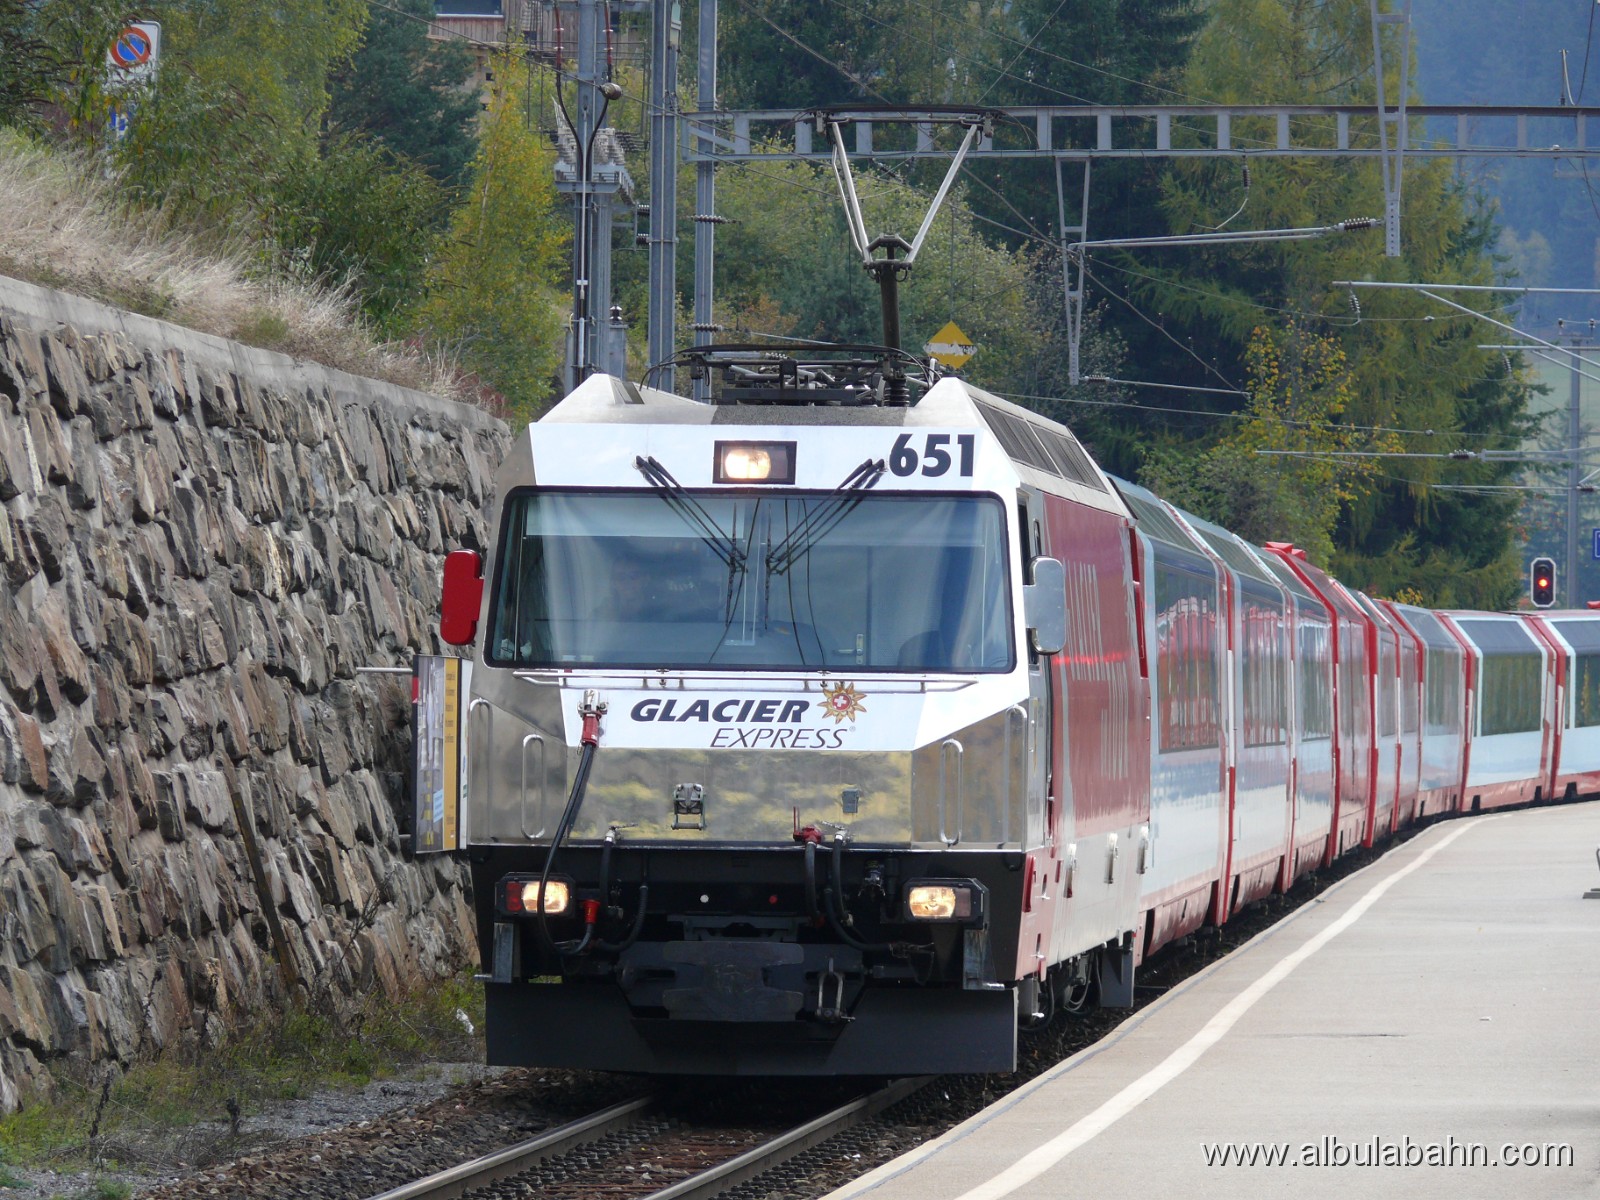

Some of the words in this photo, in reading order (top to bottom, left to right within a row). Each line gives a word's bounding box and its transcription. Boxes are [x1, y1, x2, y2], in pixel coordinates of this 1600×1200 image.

[889, 433, 976, 477] 651
[630, 698, 810, 723] GLACIER
[709, 727, 849, 749] EXPRESS
